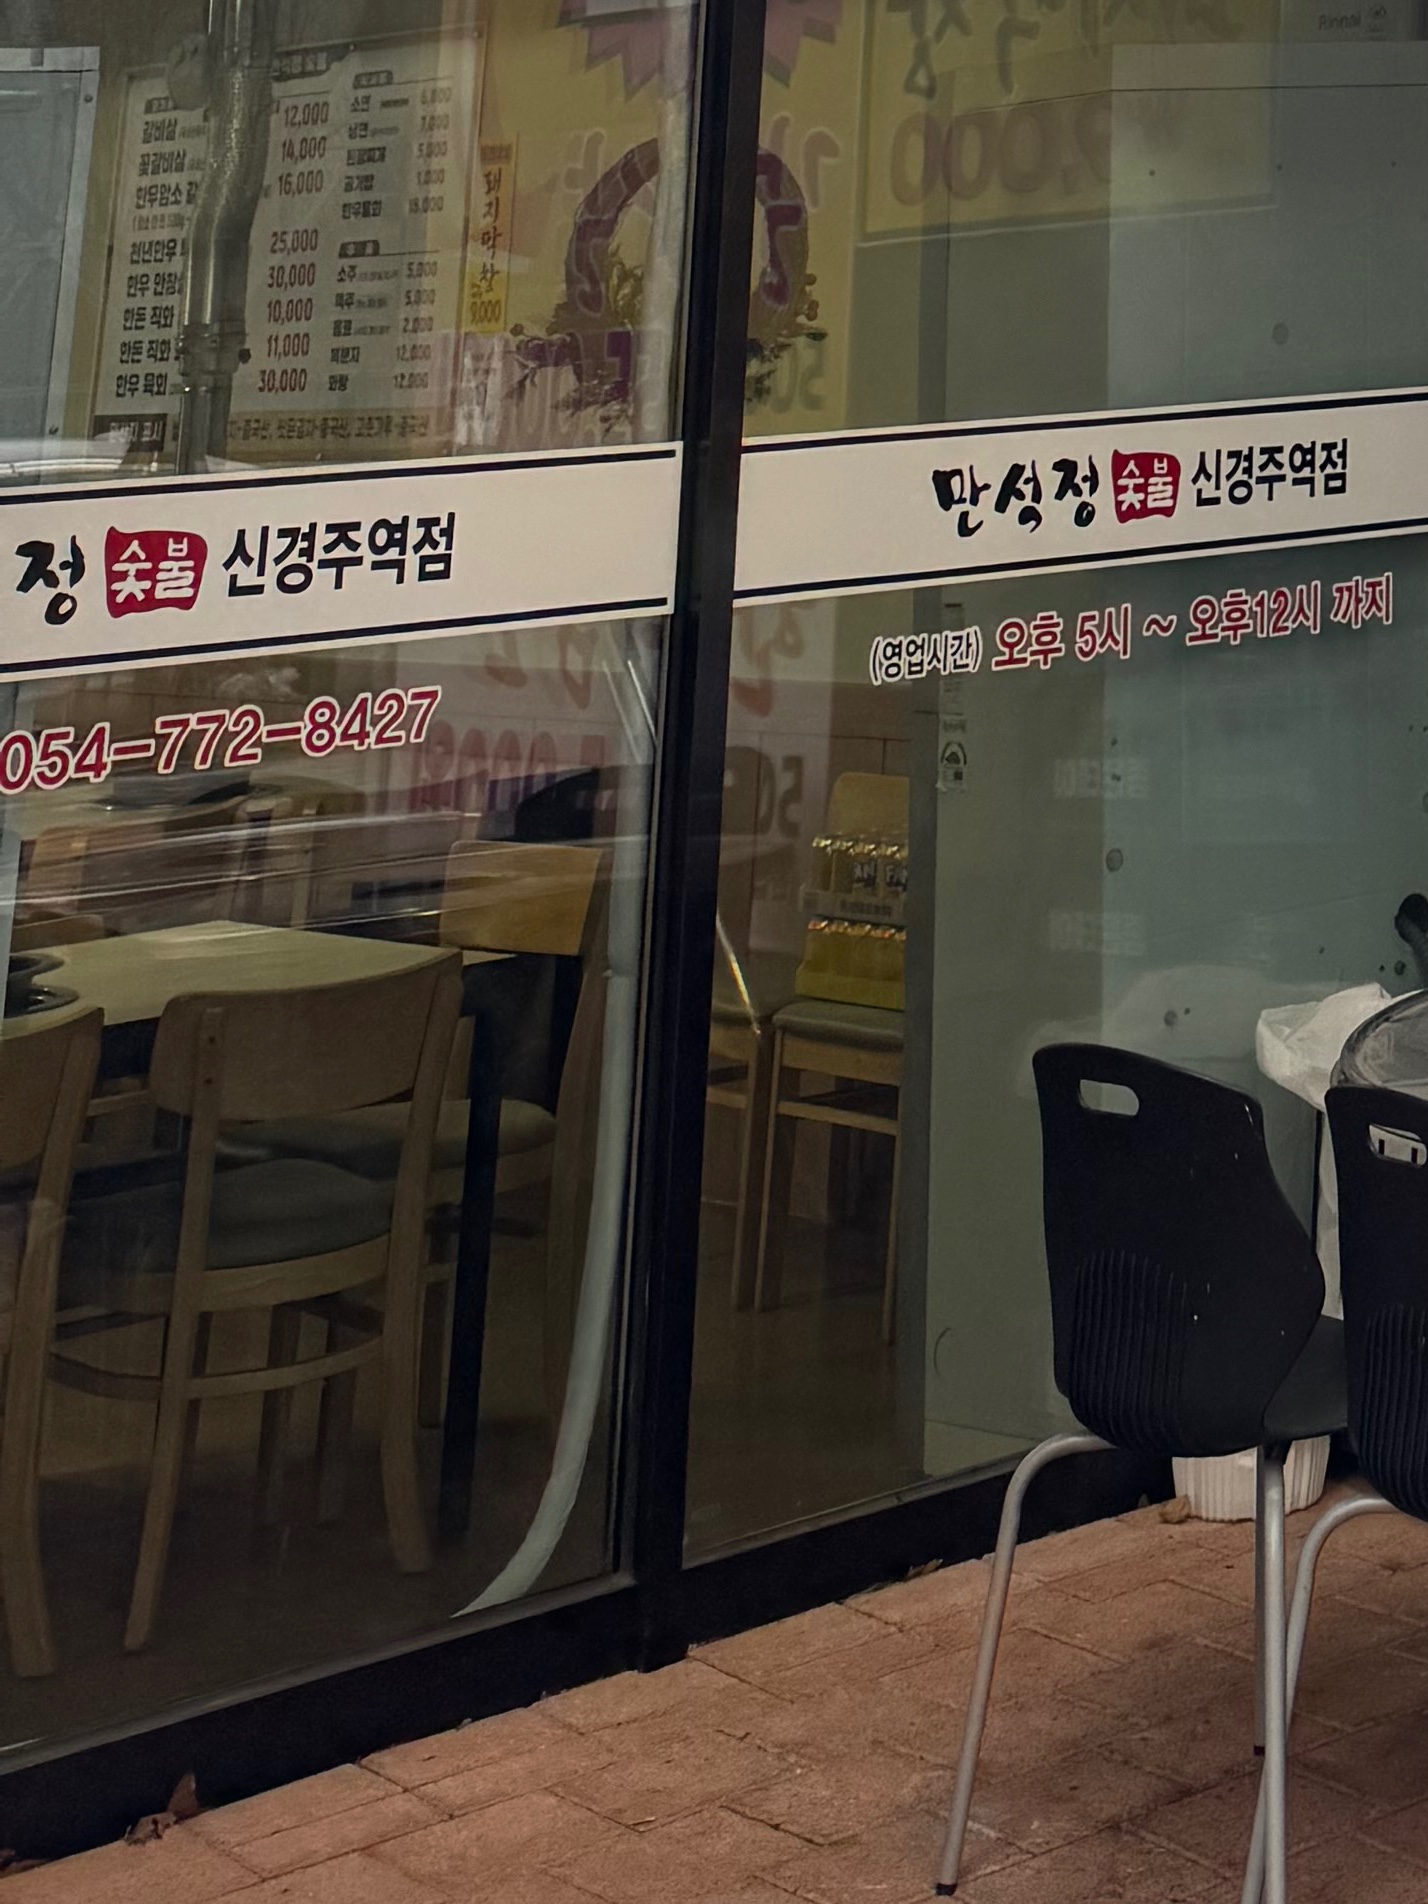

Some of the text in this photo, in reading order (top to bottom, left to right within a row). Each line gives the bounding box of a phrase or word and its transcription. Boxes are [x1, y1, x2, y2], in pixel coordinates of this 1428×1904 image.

[142, 117, 178, 145] 갈비살
[283, 101, 330, 129] 12,000
[281, 135, 327, 163] 14,000
[278, 169, 324, 197] 16,000
[270, 228, 319, 257] 25,000
[267, 262, 316, 291] 30,000
[267, 297, 314, 324] 10,000
[266, 332, 311, 361] 11,000
[258, 368, 308, 395] 30,000
[1117, 457, 1178, 511] 숯불
[1191, 437, 1349, 509] 신경주역점
[109, 537, 197, 604] 숯불
[222, 511, 456, 597] 신경주역점
[868, 626, 985, 687] (영업시간)
[992, 610, 1063, 673] 오후
[1074, 602, 1133, 661] 5시
[1330, 572, 1395, 629] 까지
[0, 686, 442, 794] 054-772-8427
